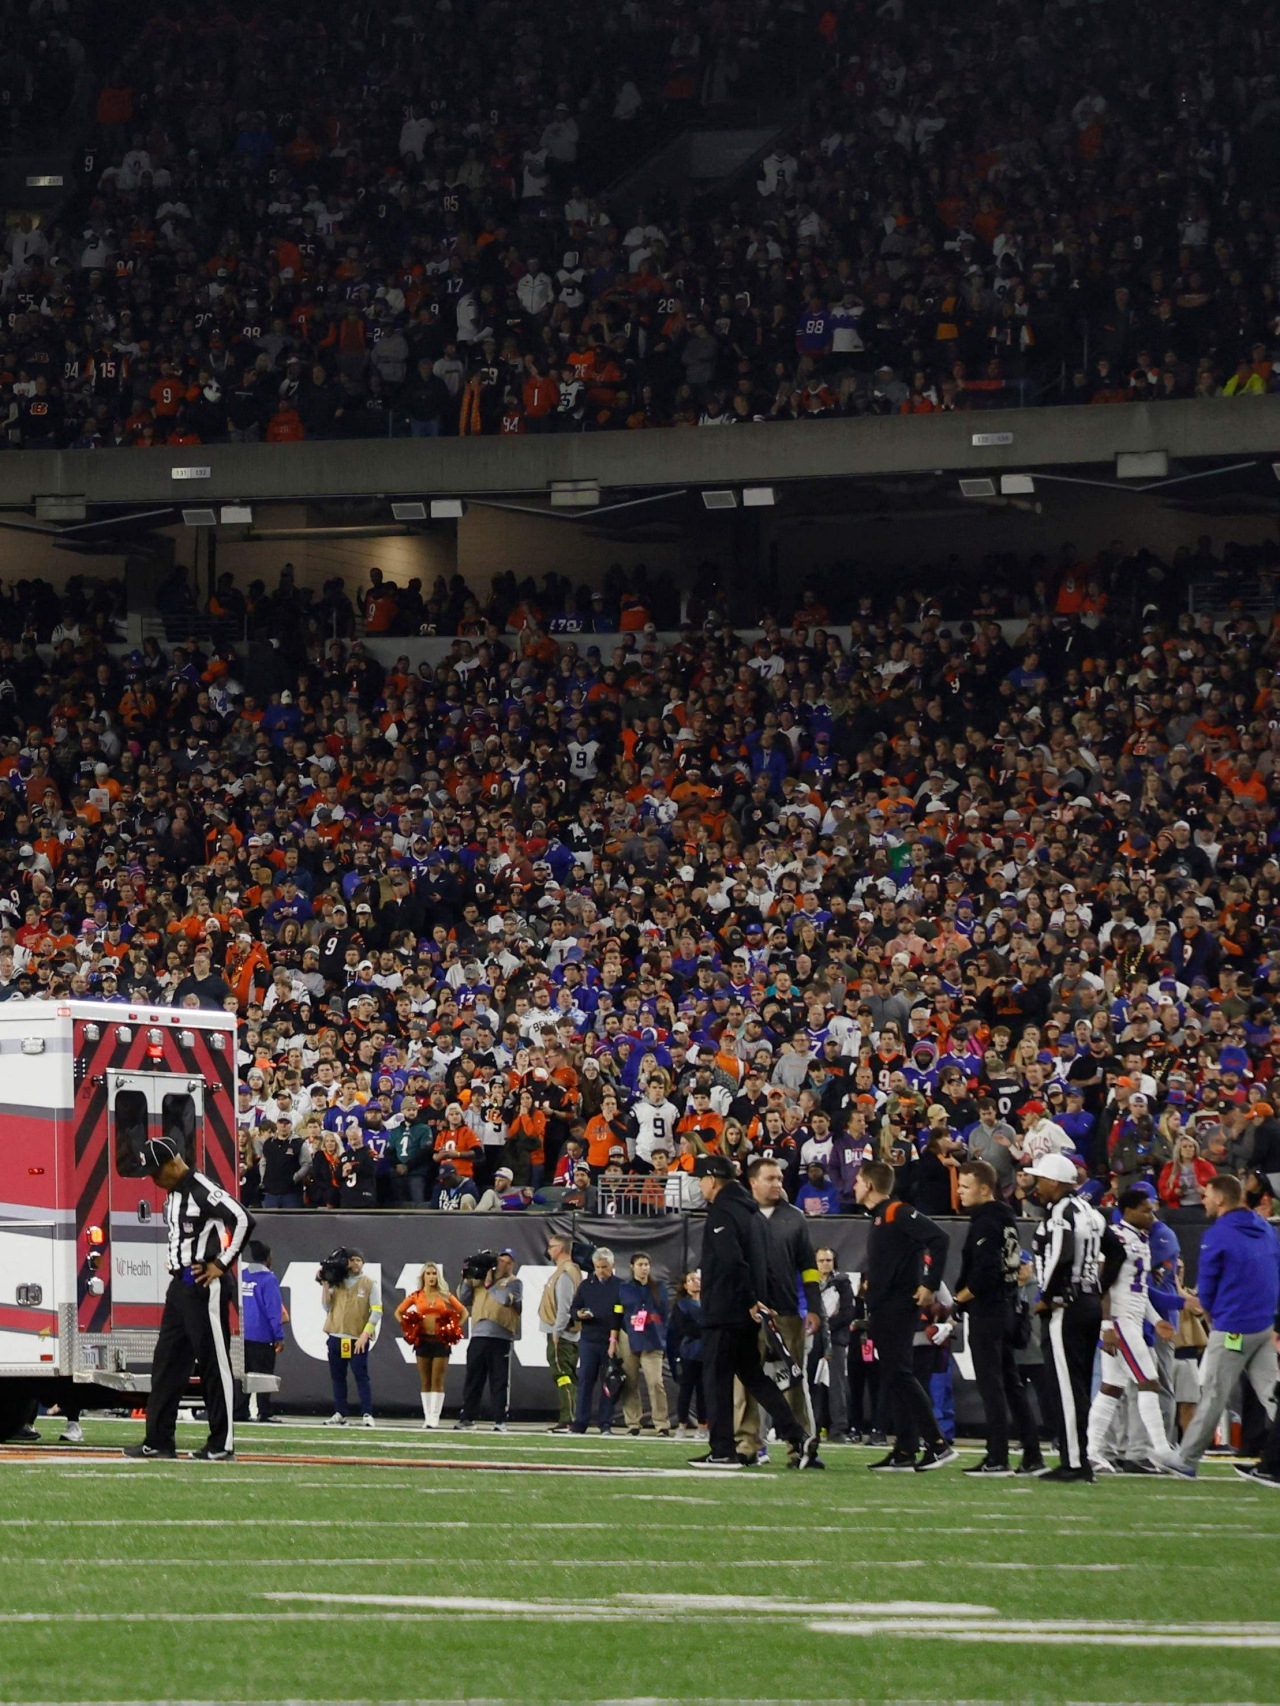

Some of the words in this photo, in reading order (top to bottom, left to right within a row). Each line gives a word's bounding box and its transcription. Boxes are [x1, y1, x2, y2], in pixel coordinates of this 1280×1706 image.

[85, 157, 94, 172] 9
[443, 196, 459, 211] 85
[299, 244, 315, 256] 55
[447, 278, 463, 294] 17
[805, 320, 824, 334] 88
[100, 362, 116, 378] 15
[162, 388, 172, 403] 9
[503, 416, 519, 432] 94
[368, 604, 375, 622] 9
[1065, 636, 1074, 652] 1
[950, 678, 960, 694] 9
[575, 752, 586, 767] 9
[10, 890, 20, 904] 9
[325, 937, 337, 955] 9
[458, 994, 476, 1009] 17
[878, 1070, 890, 1090] 9
[999, 1097, 1011, 1114] 0
[653, 1117, 665, 1138] 9
[368, 1139, 388, 1158] 17
[399, 1136, 409, 1156] 1
[127, 1258, 152, 1276] Health
[637, 1317, 645, 1328] 9
[342, 1342, 351, 1353] 9
[863, 1343, 872, 1356] 9
